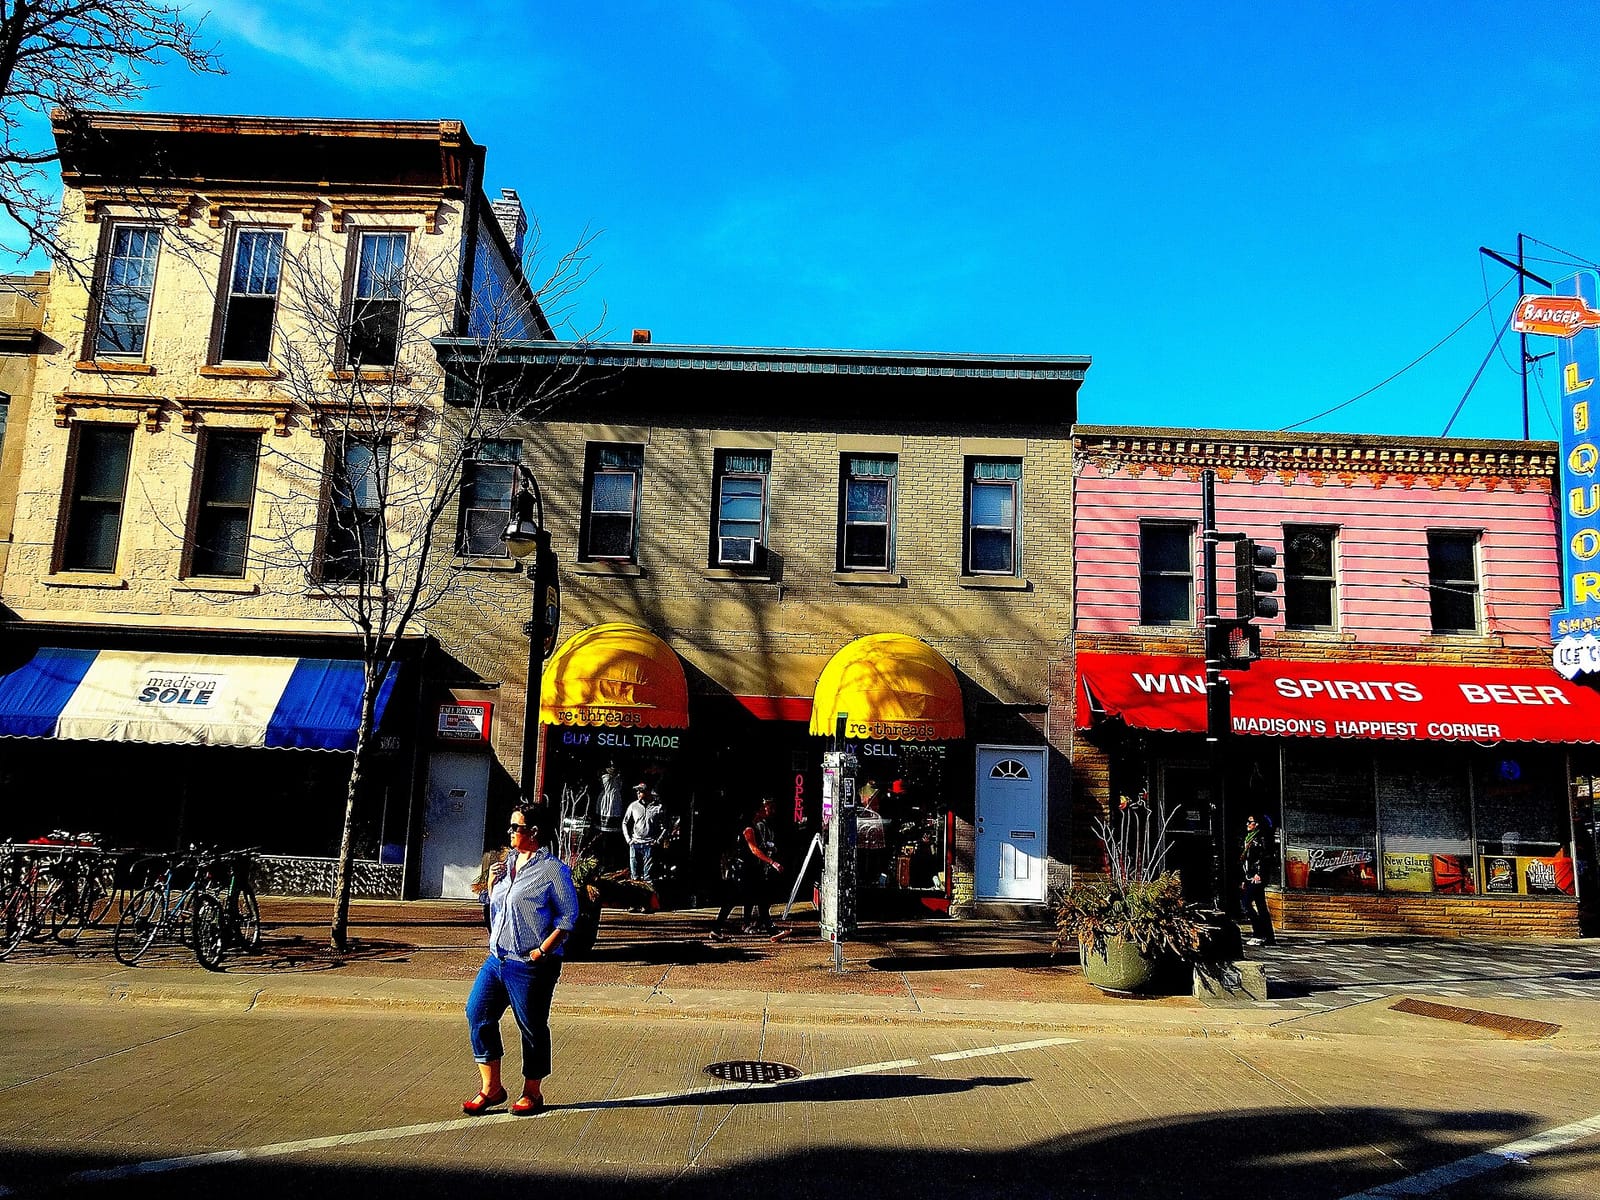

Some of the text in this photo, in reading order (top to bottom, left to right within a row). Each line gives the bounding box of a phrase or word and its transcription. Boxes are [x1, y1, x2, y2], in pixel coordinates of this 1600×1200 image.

[1523, 303, 1580, 325] BADGER
[1563, 362, 1600, 606] LIQUOR
[146, 675, 217, 690] madison
[1131, 673, 1571, 705] WIN SPIRITS BEER
[138, 686, 214, 705] SOLE
[1232, 716, 1502, 738] MADISON'S HAPPIEST CORNER
[563, 731, 680, 748] BUY SELL TRADE
[863, 743, 897, 757] SELL
[794, 774, 804, 823] OPEN
[1384, 856, 1403, 866] New
